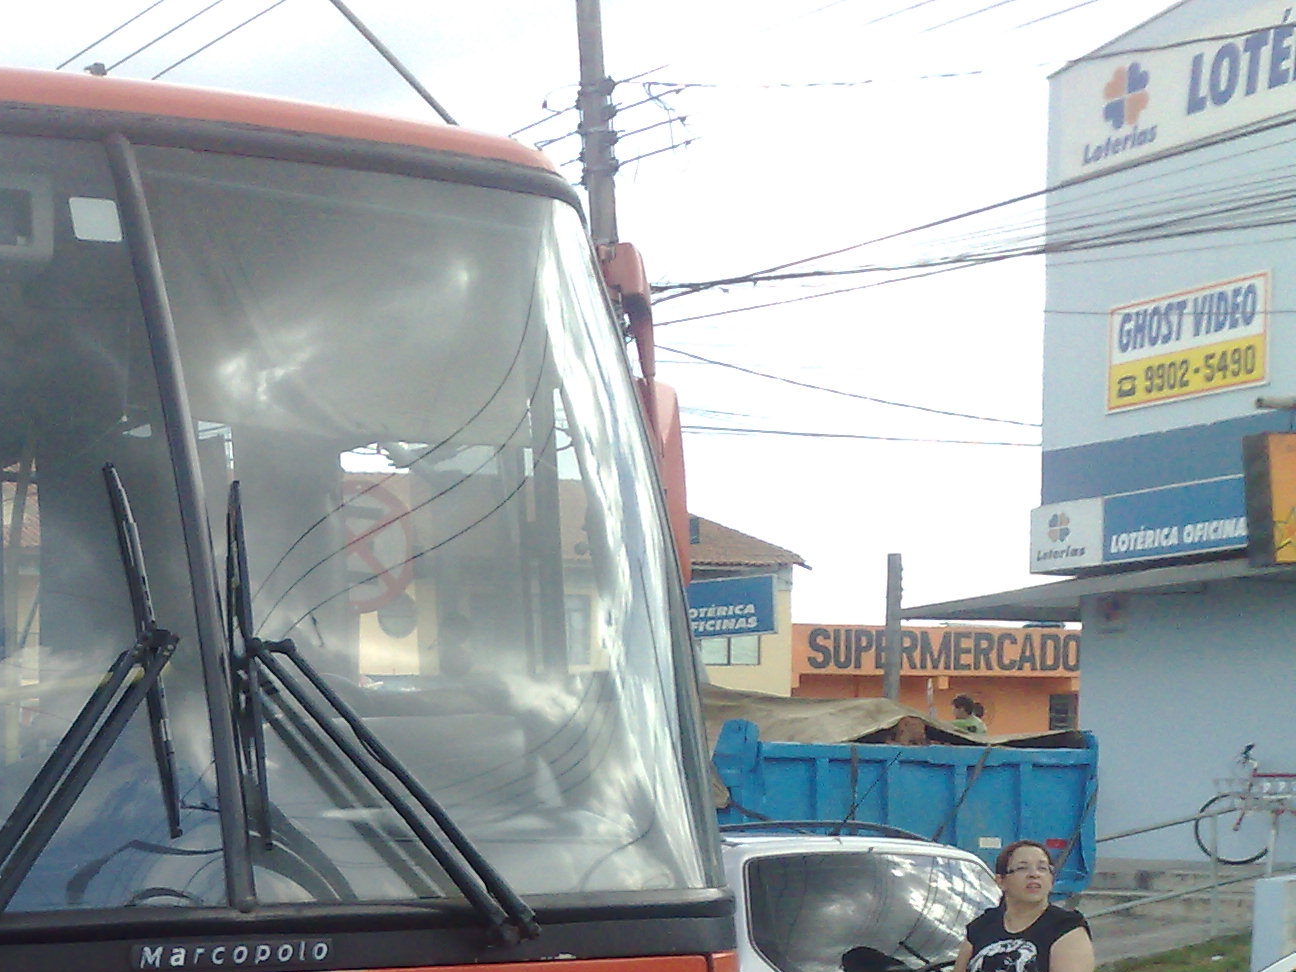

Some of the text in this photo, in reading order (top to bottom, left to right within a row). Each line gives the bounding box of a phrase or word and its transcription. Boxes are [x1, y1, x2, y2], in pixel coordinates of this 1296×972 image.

[1187, 7, 1296, 115] LOTÉ
[1118, 283, 1257, 353] GHOST VIDEO
[1110, 525, 1179, 553] LOTÉRICA
[688, 604, 755, 618] OTÉRICA
[690, 616, 758, 632] FICINAS
[140, 941, 329, 969] Marcopolo
